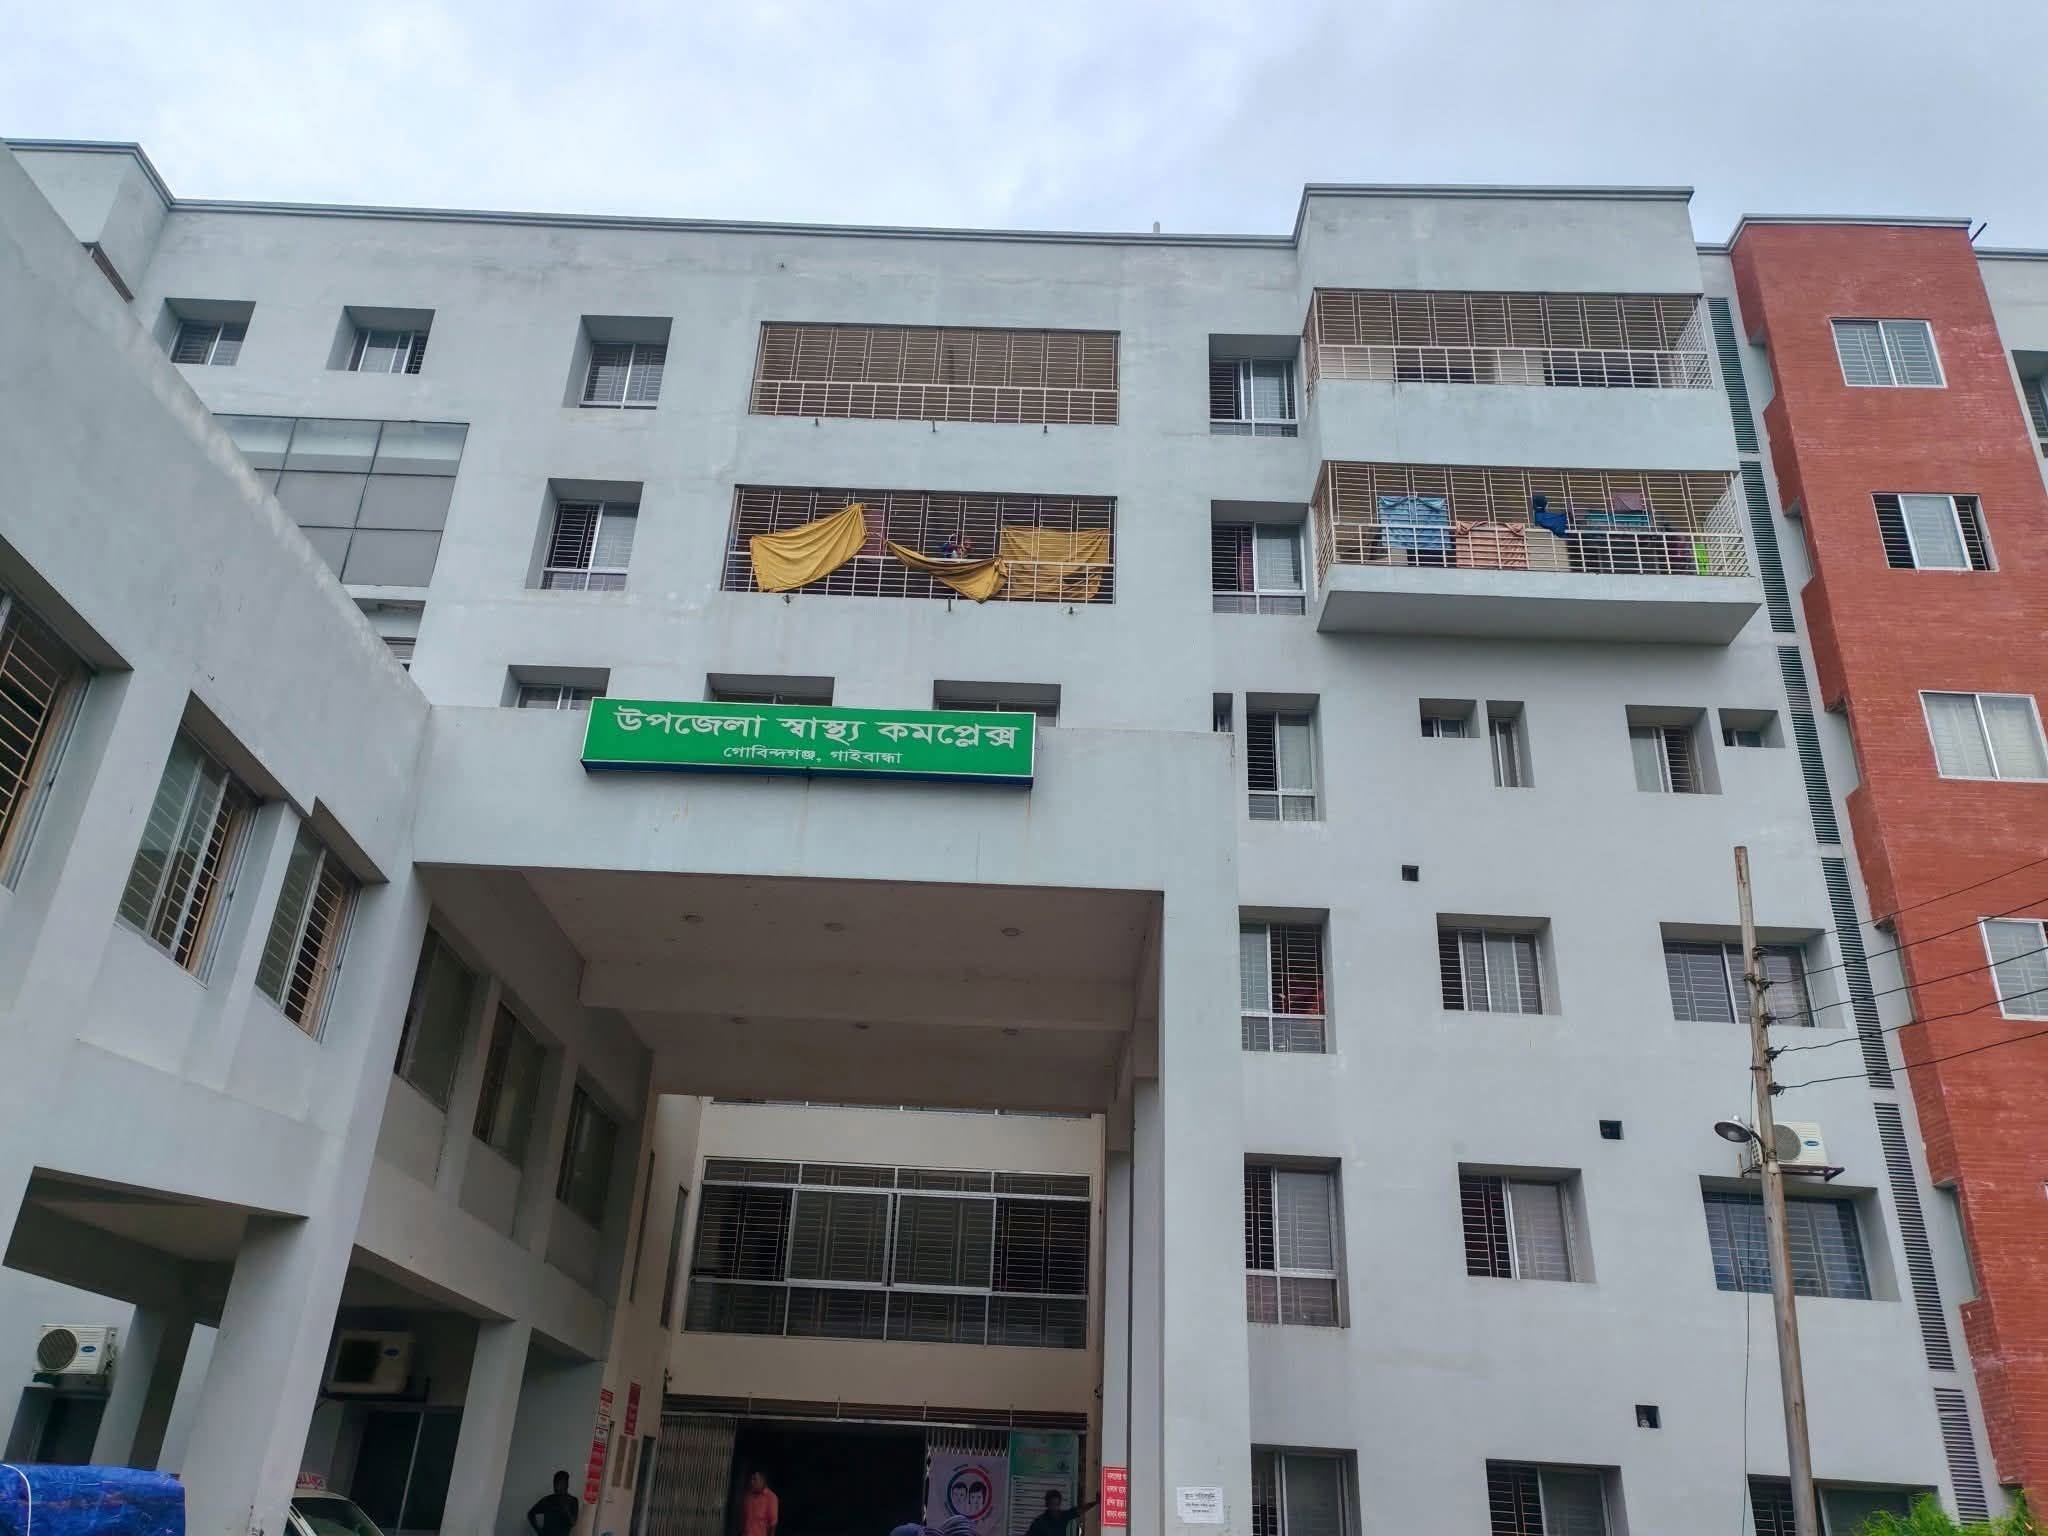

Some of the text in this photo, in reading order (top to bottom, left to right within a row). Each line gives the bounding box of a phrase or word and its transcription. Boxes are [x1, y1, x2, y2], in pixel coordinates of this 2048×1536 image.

[613, 705, 1022, 749] উপজেলা স্বাস্থ্য কমপ্লেক্স
[830, 748, 903, 764] গাইবান্ধা
